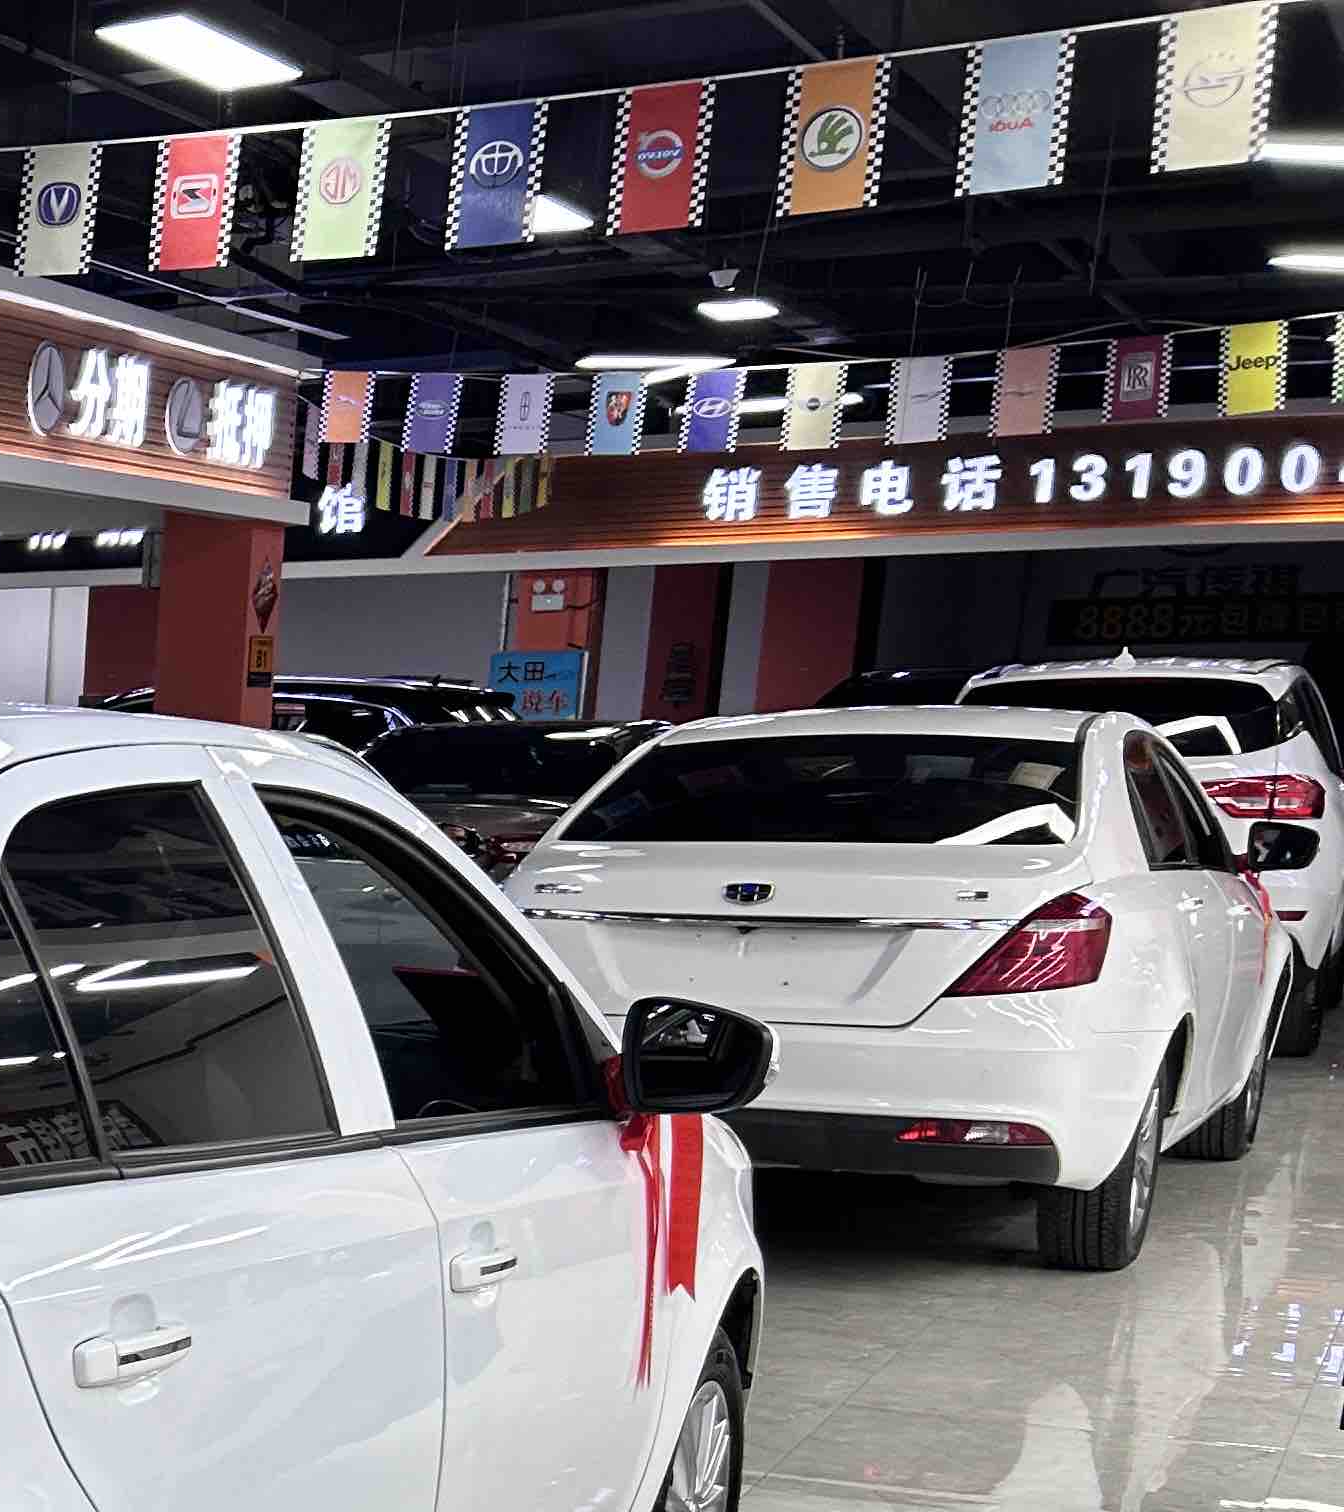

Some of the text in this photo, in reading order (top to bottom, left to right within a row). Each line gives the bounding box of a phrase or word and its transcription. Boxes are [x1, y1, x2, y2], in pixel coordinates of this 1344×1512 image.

[1228, 354, 1279, 371] Jeep
[67, 348, 151, 448] 分期
[317, 482, 366, 534] 馆
[702, 443, 1344, 520] 销售电话 131900
